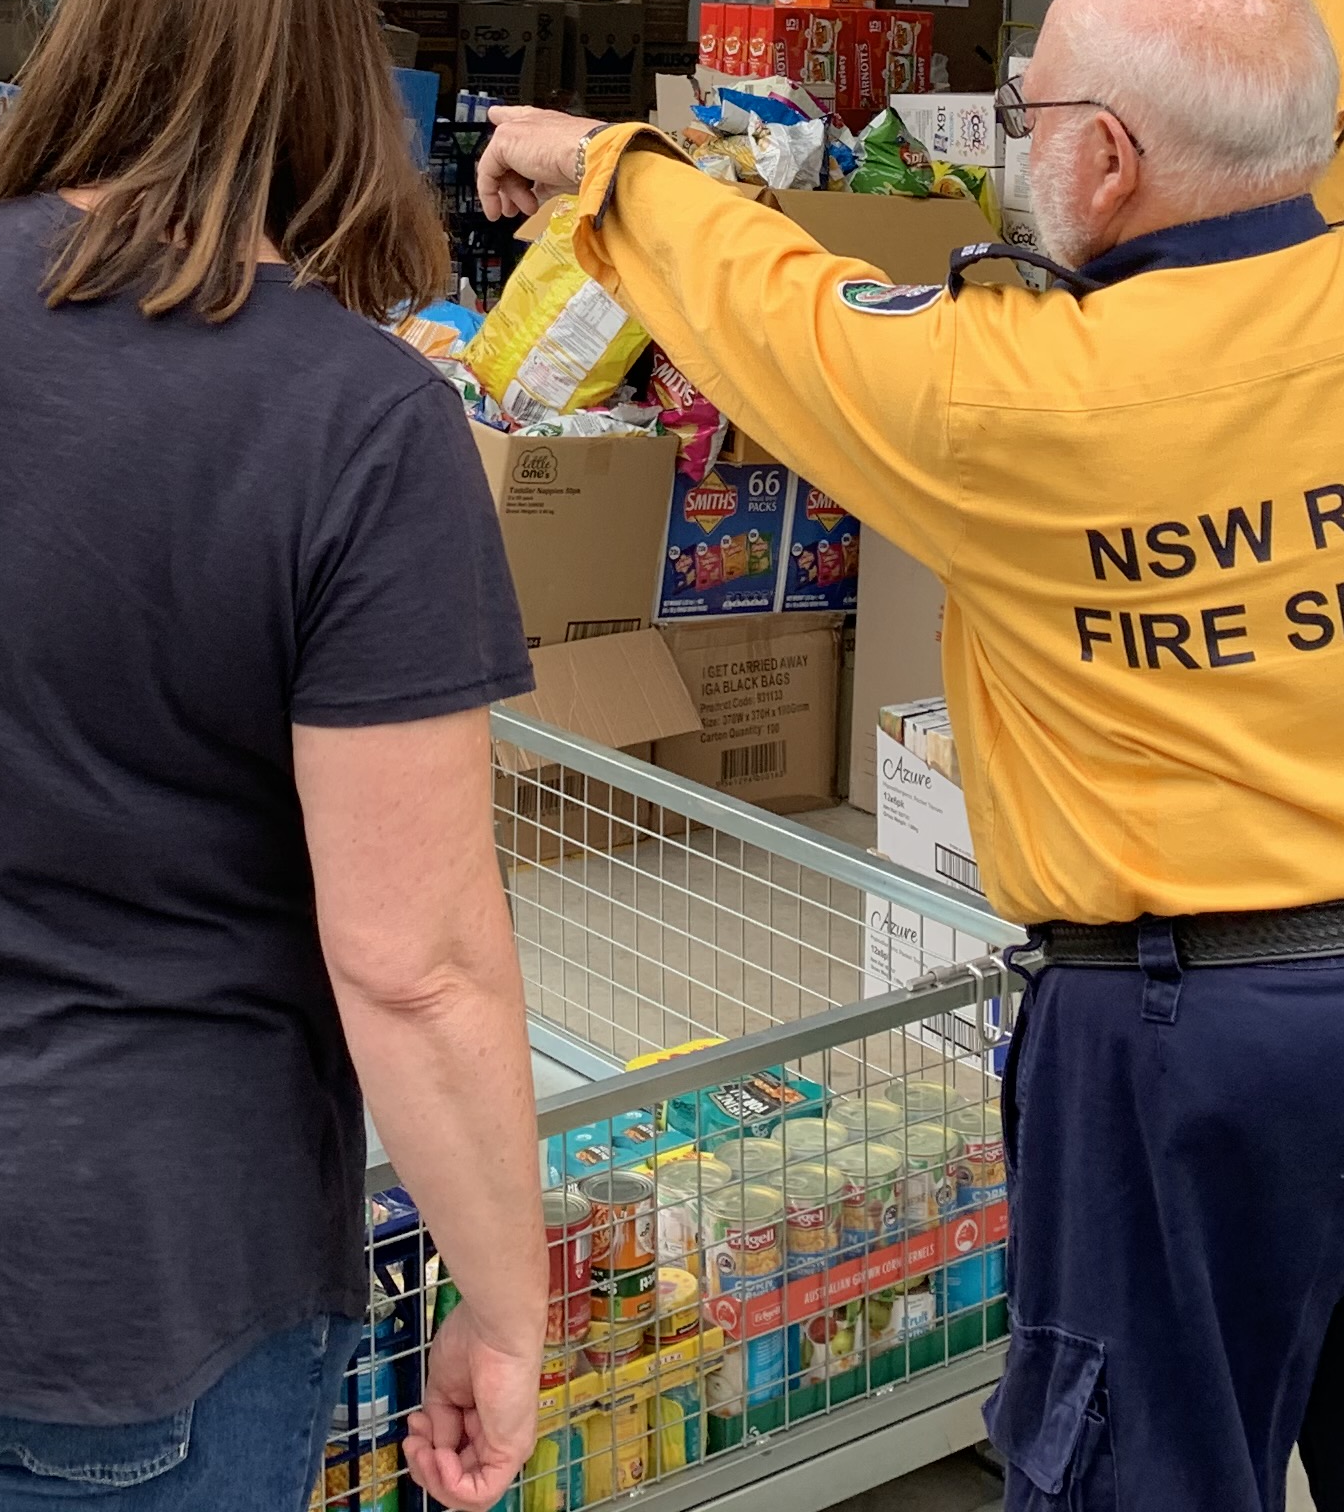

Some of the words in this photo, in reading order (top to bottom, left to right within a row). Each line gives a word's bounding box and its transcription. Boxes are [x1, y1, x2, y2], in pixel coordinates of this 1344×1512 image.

[839, 55, 847, 93] Variety
[521, 468, 550, 479] one's
[522, 452, 552, 470] little
[748, 470, 781, 496] 66
[748, 501, 777, 512] PACKS
[1085, 500, 1273, 581] NSW
[1074, 604, 1256, 671] FIRE
[708, 663, 729, 678] GET
[731, 657, 778, 676] CARRIED
[780, 655, 808, 669] AWAY
[701, 683, 721, 696] IGA
[723, 677, 759, 694] BLACK
[761, 672, 790, 687] BAGS
[700, 732, 728, 744] Carton
[883, 756, 932, 789] Azure
[871, 909, 918, 944] Azure
[804, 1277, 851, 1306] AUSTALIAN
[904, 1244, 935, 1266] ERNELS
